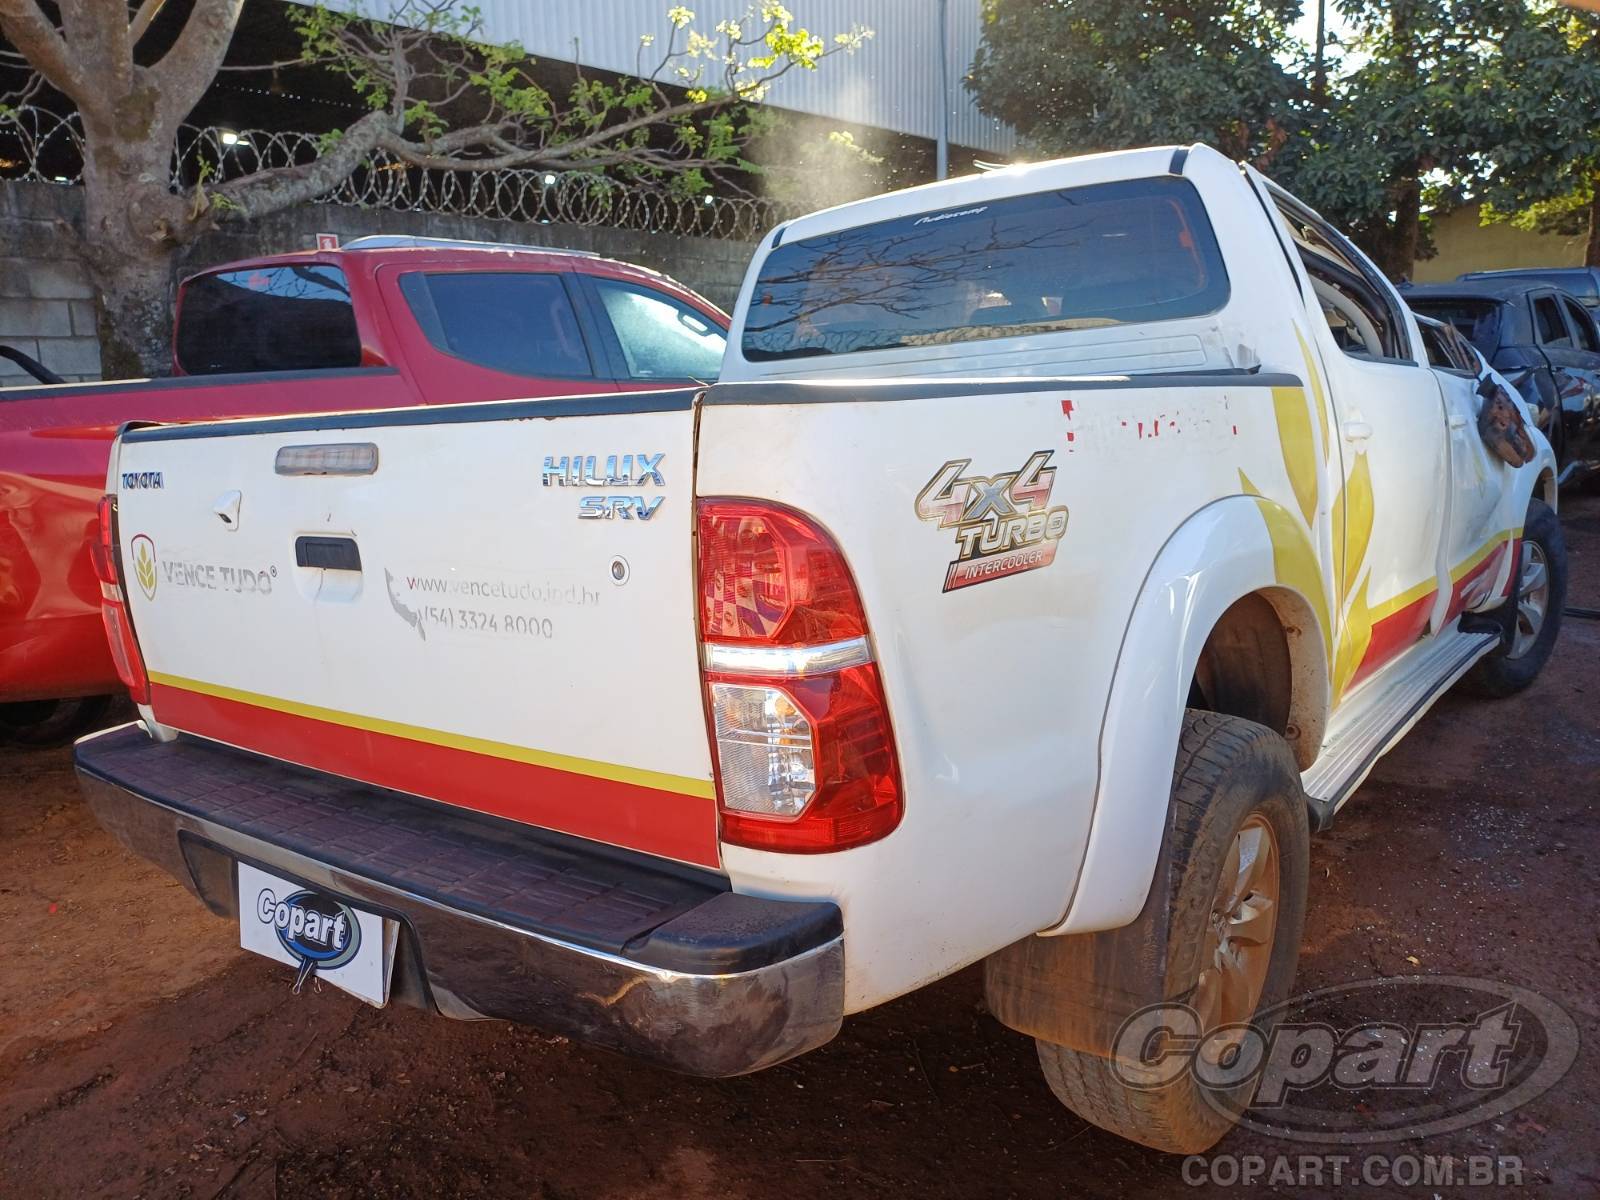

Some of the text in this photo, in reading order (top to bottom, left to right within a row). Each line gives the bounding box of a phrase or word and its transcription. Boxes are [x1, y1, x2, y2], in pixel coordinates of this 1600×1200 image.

[122, 472, 163, 489] TOYOTA
[542, 453, 666, 486] HILUX
[577, 496, 666, 520] SRV
[956, 505, 1069, 560] TURBO
[162, 561, 216, 590] VENCE
[965, 551, 1043, 579] INTERCOOLER
[424, 606, 553, 639] (54) 3324 8000
[257, 888, 347, 951] Copart
